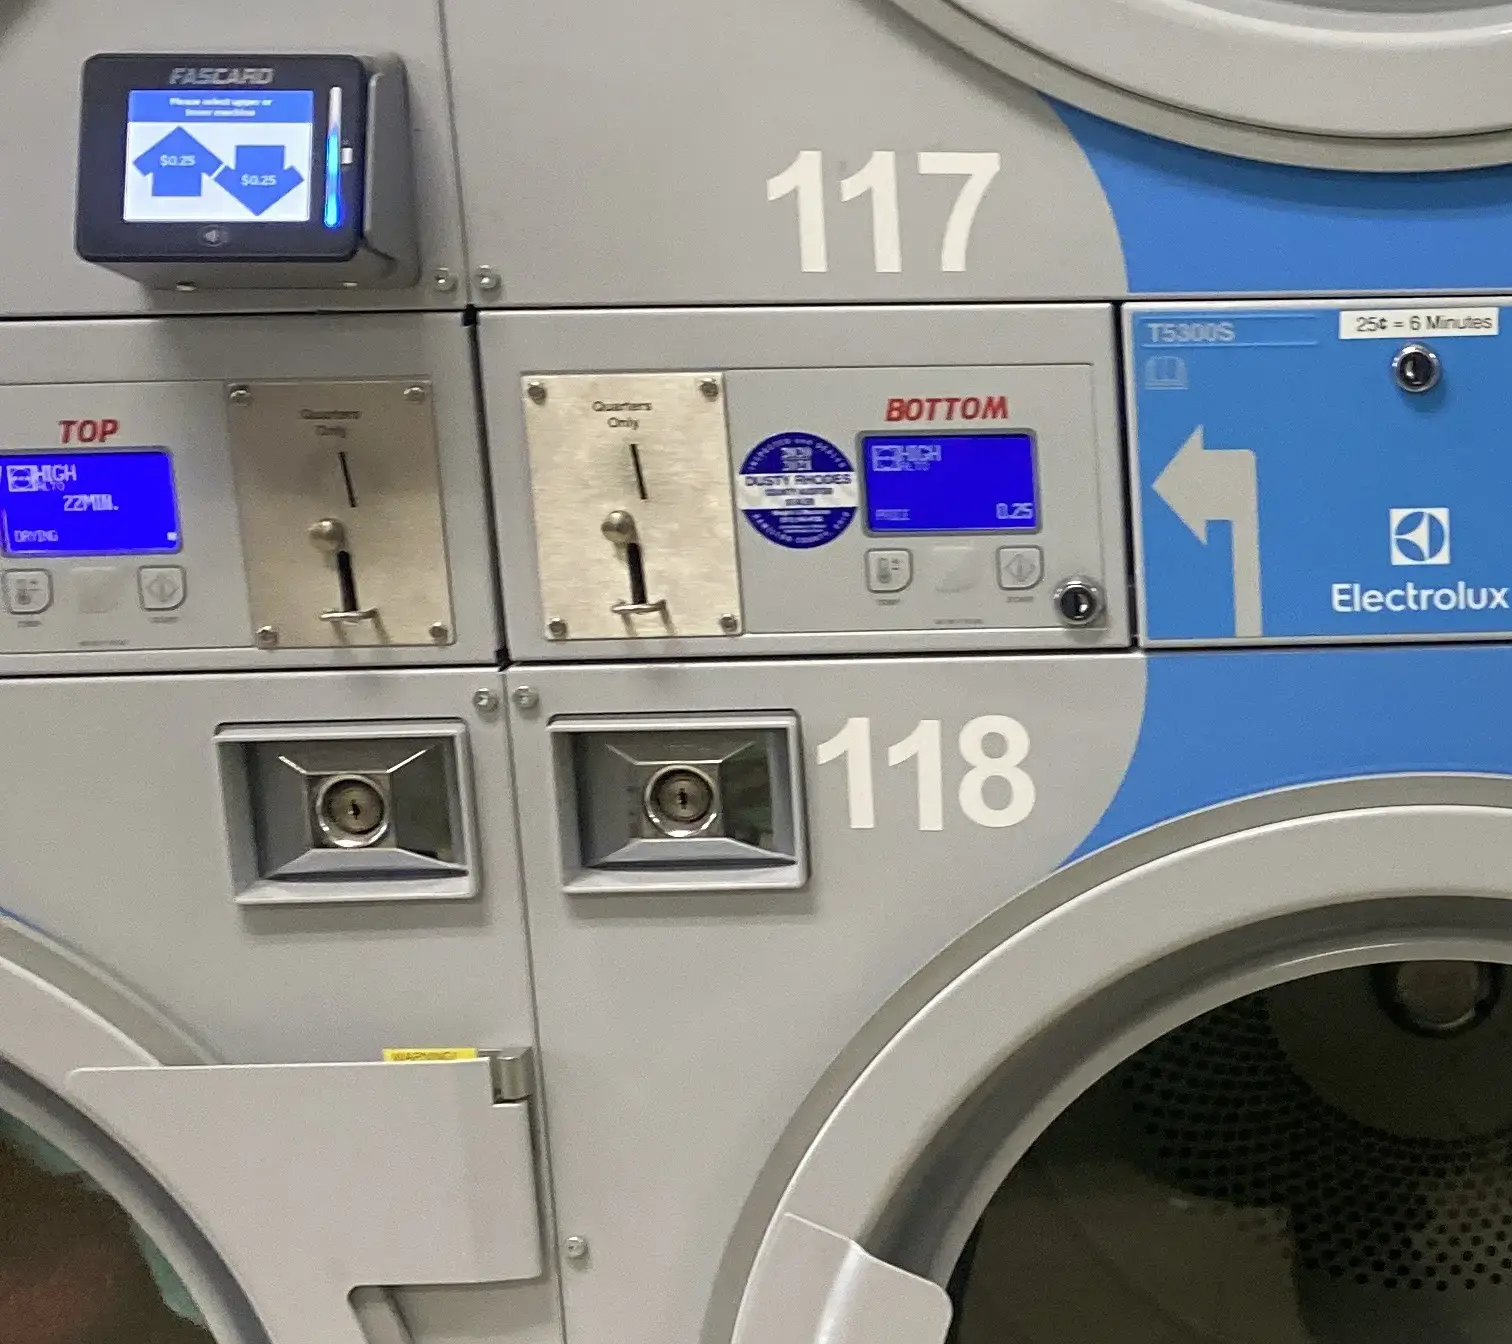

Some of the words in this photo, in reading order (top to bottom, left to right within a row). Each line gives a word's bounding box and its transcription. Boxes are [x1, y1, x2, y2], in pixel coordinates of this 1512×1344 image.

[168, 67, 275, 85] FASCARD
[159, 154, 196, 167] $0.25
[240, 174, 277, 186] $0.25
[766, 150, 1001, 273] 117
[1147, 322, 1236, 343] T5300S
[1356, 316, 1388, 332] 25¢
[1409, 316, 1420, 330] 6
[1426, 315, 1493, 330] Minutes
[884, 396, 1009, 422] BOTTOM
[58, 419, 120, 444] TOP
[36, 464, 78, 483] HIGH
[745, 475, 790, 487] DUSTY
[794, 473, 852, 485] RHODES
[996, 502, 1034, 520] 0.25
[14, 529, 59, 543] DRYING
[1331, 581, 1510, 613] Electrolux
[816, 714, 1037, 831] 118
